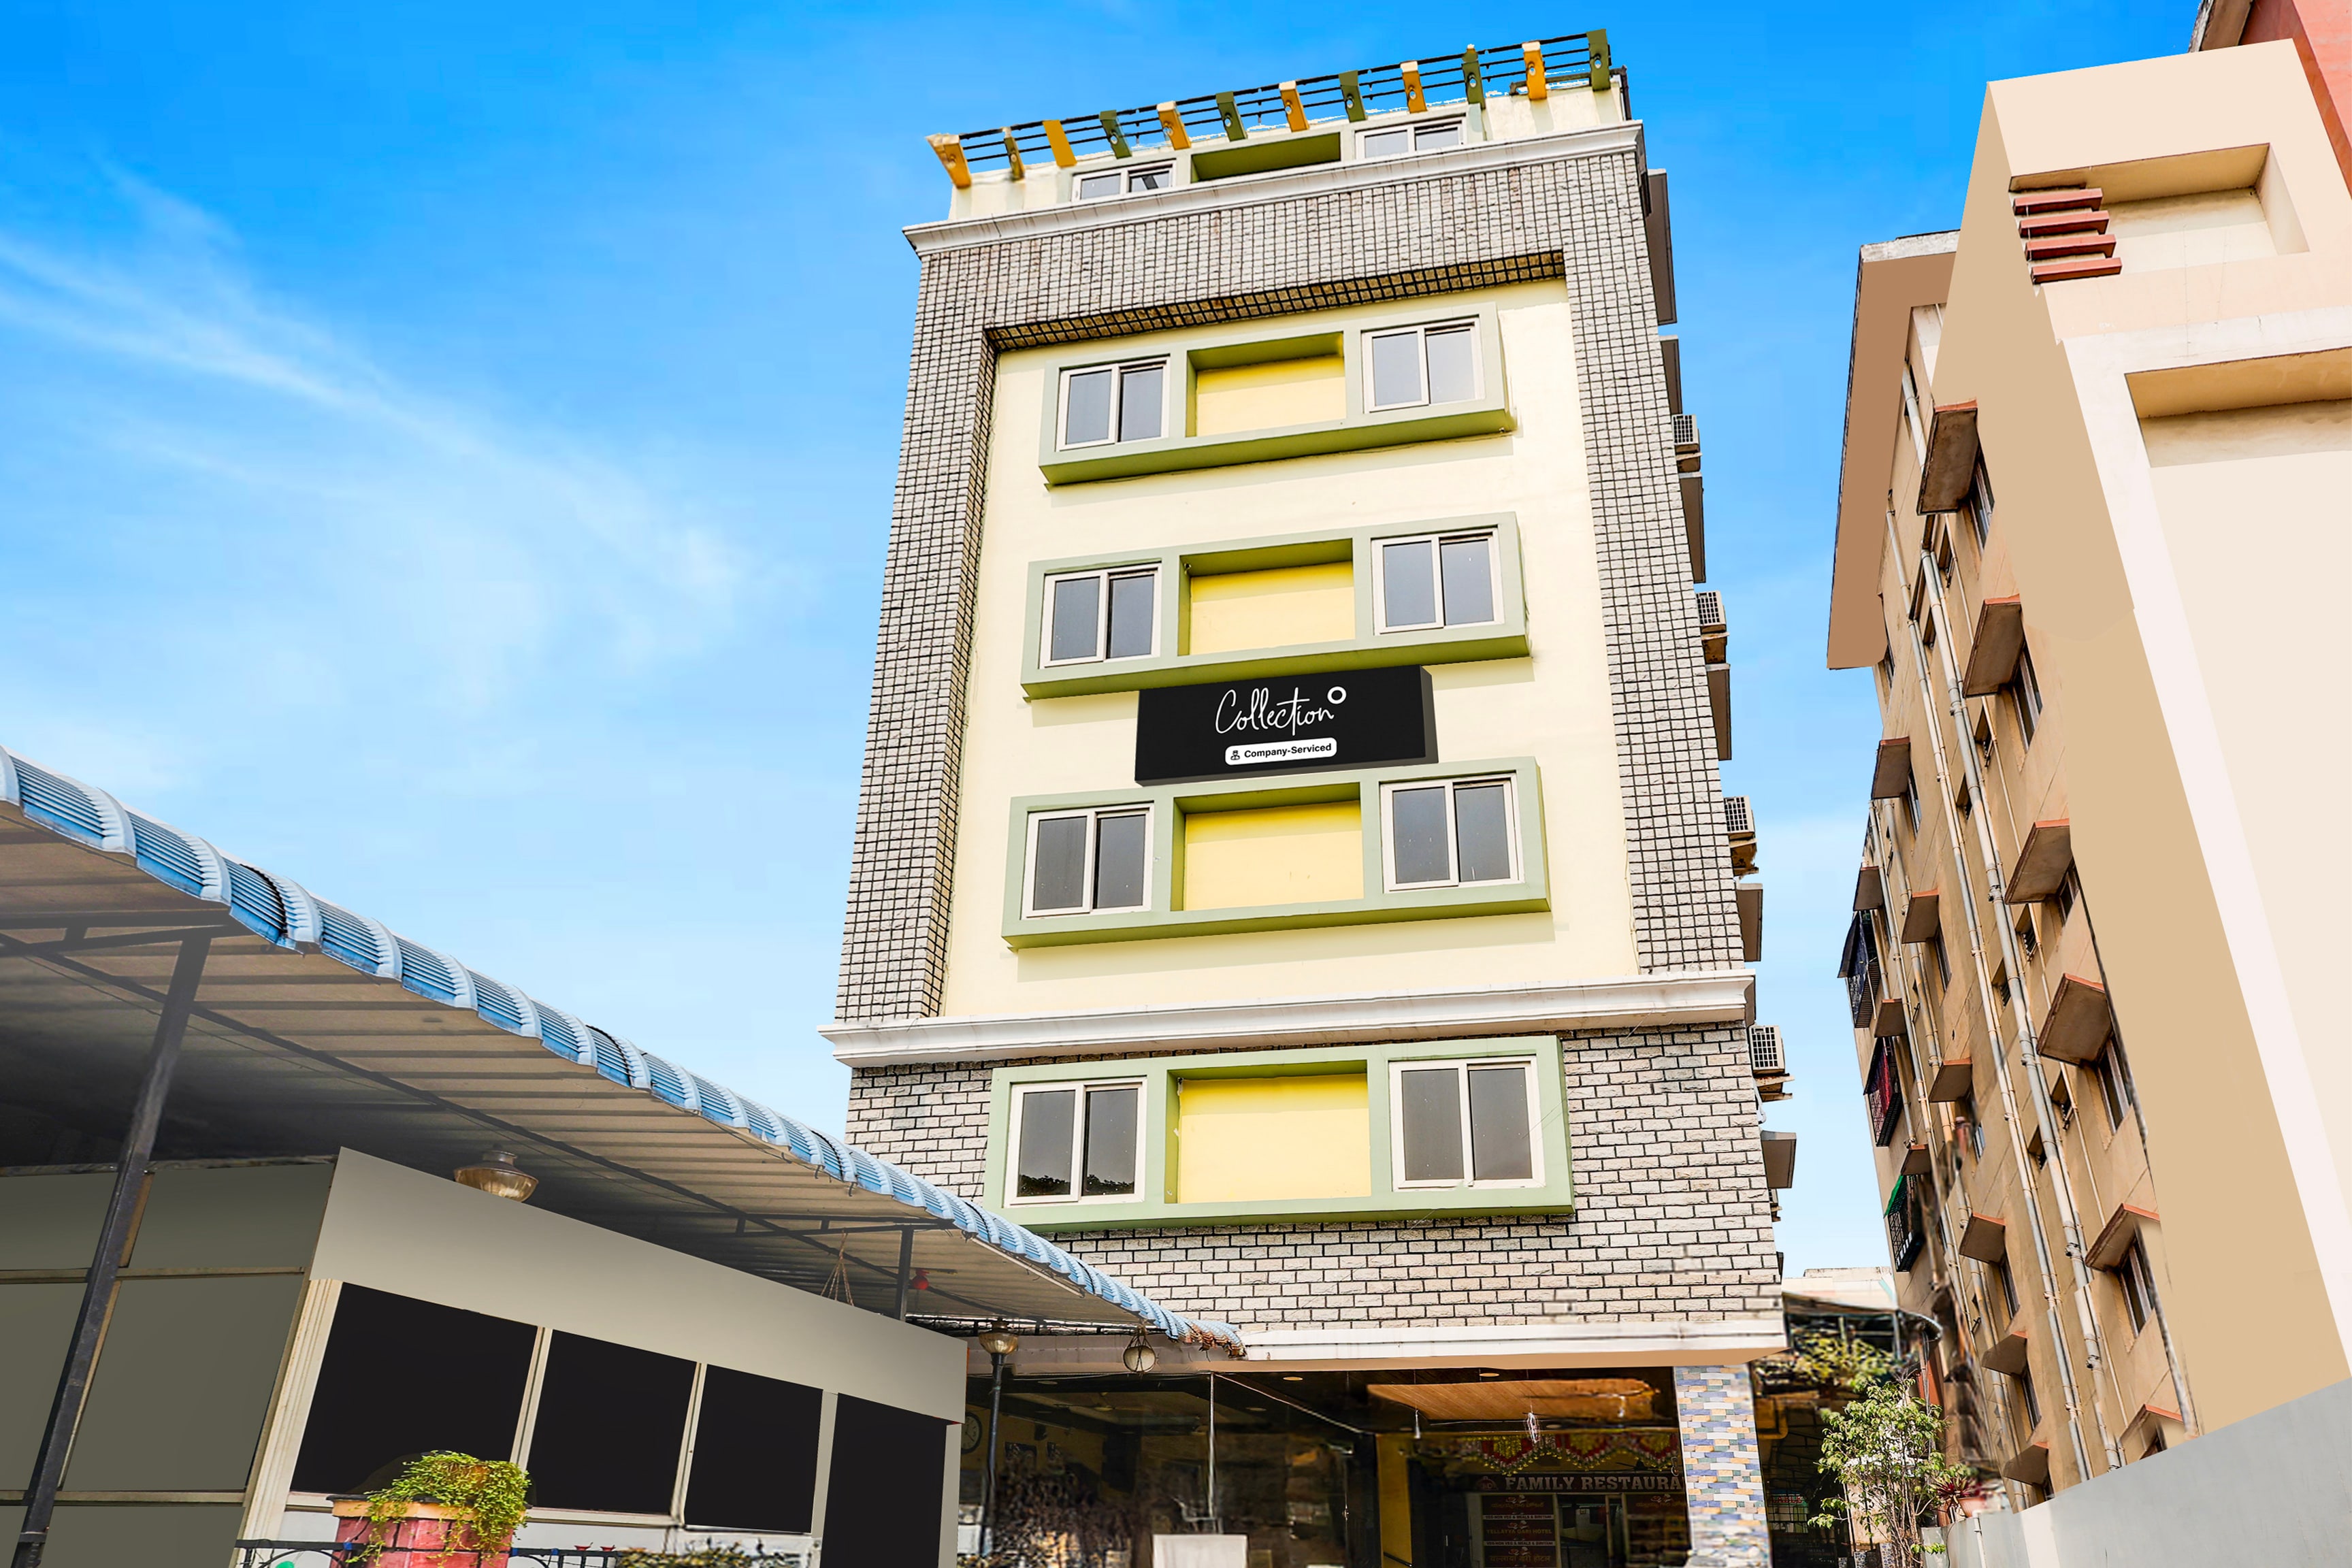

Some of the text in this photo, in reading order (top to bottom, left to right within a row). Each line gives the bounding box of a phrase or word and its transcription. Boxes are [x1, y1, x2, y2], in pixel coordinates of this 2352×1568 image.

[1215, 687, 1335, 736] Collection
[1244, 742, 1332, 759] Company-Serviced
[1505, 1476, 1575, 1491] FAMILY
[1581, 1475, 1683, 1491] RESTAURA
